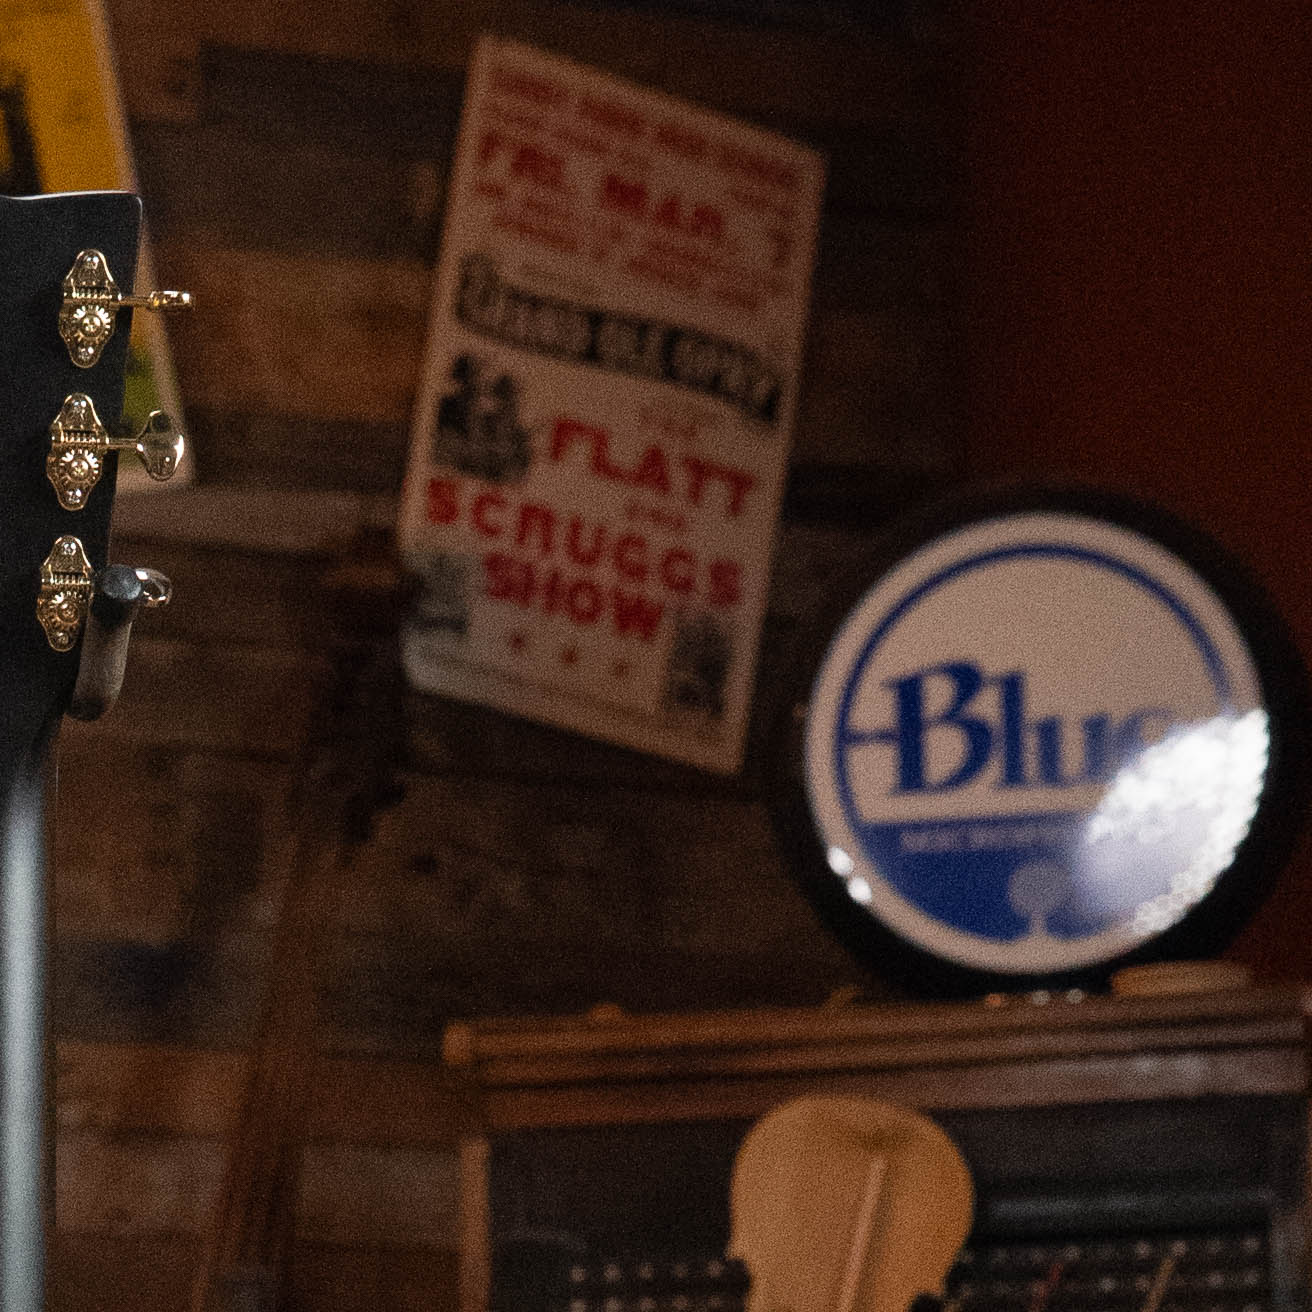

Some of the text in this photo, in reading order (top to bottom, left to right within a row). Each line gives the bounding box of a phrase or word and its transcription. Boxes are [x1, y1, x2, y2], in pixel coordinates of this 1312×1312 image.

[547, 417, 759, 518] FLATT
[424, 477, 745, 607] SCRUGGS
[481, 552, 666, 641] SHOW
